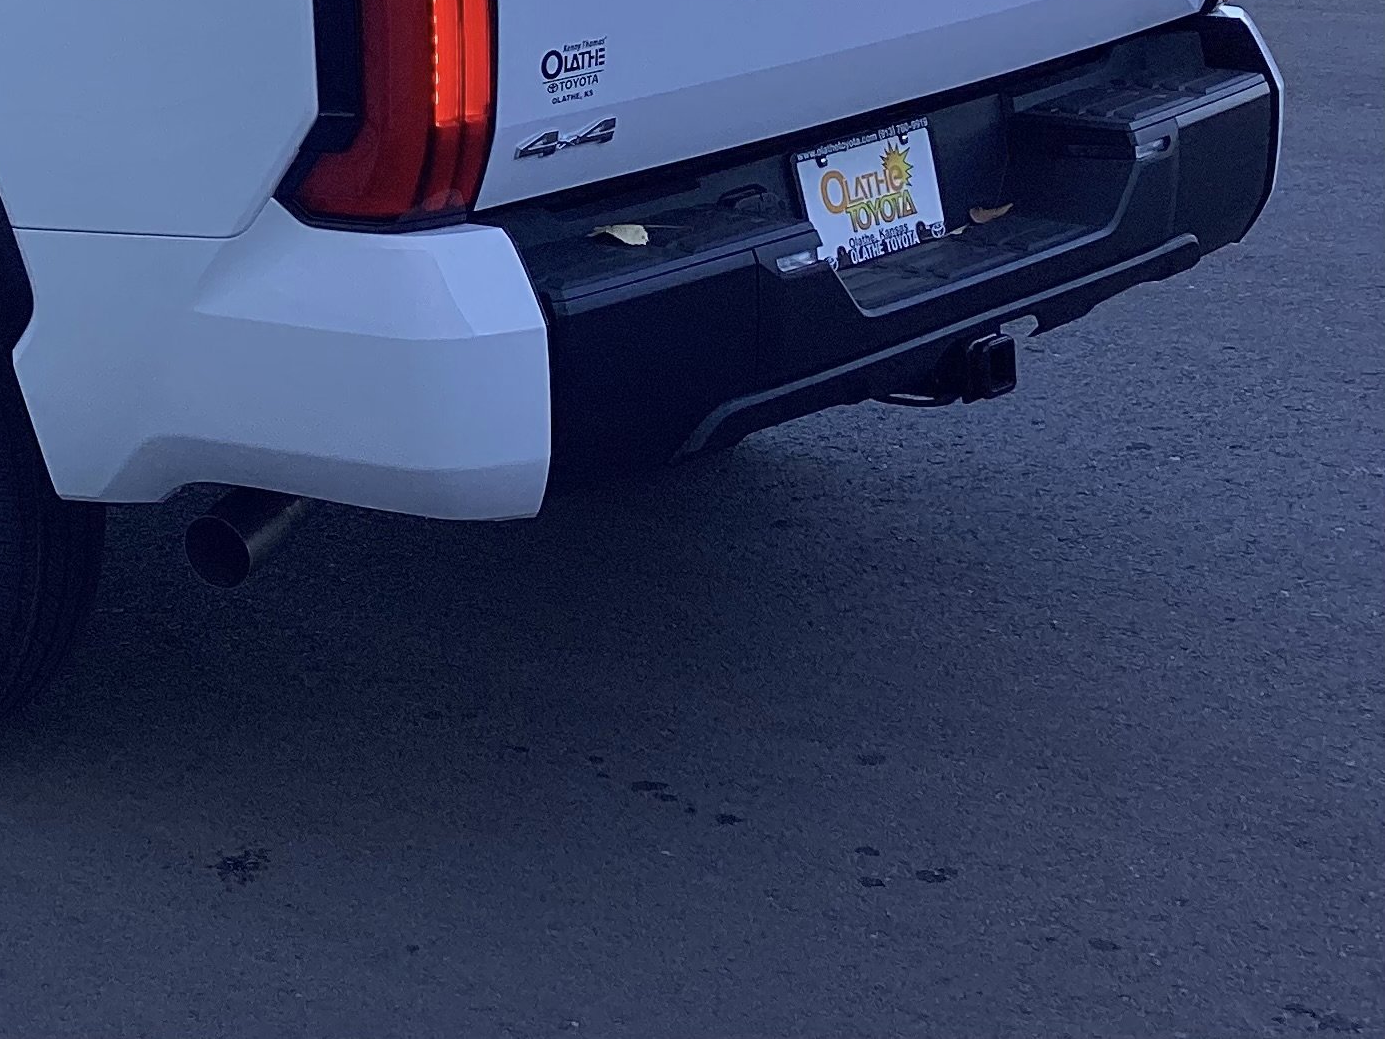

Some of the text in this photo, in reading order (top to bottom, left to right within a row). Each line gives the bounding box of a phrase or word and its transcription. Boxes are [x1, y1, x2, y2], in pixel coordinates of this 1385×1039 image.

[541, 48, 605, 80] OLATHE
[551, 89, 594, 104] OLATHE, KS
[559, 74, 599, 91] TOYOTA
[796, 133, 878, 161] www.olathetoyota.com
[846, 189, 918, 232] TOYOTA
[878, 223, 909, 240] Kansas
[850, 229, 921, 264] OLATHE TOYOTA
